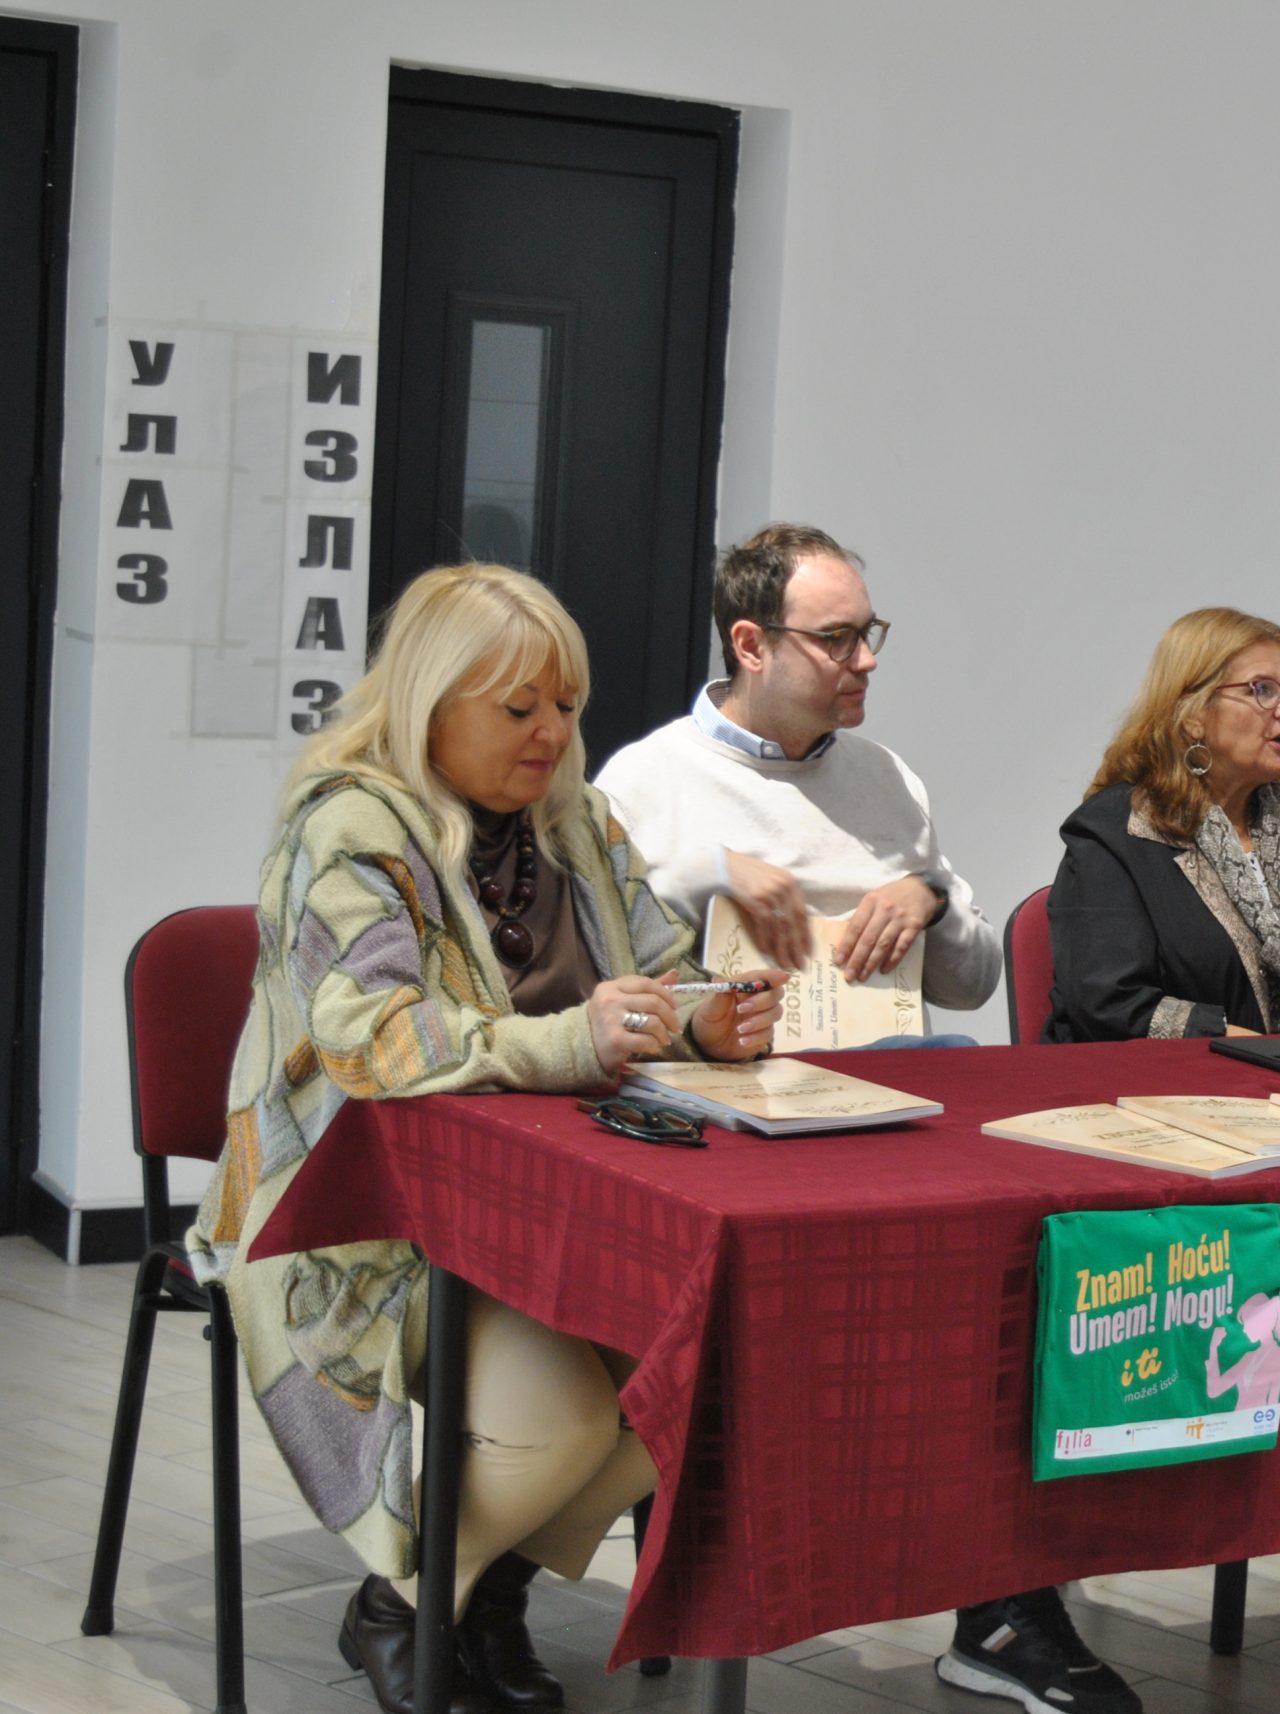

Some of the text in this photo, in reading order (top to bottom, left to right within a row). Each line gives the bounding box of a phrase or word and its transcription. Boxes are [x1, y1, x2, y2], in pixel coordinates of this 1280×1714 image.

[116, 340, 177, 604] УЛАЗ
[291, 352, 361, 735] ИЗЛАЗ
[1076, 1230, 1230, 1312] Znam! Hoću!
[1070, 1274, 1234, 1355] Umem! Mogu!
[1121, 1347, 1162, 1387] i ti
[1124, 1383, 1158, 1403] možeš
